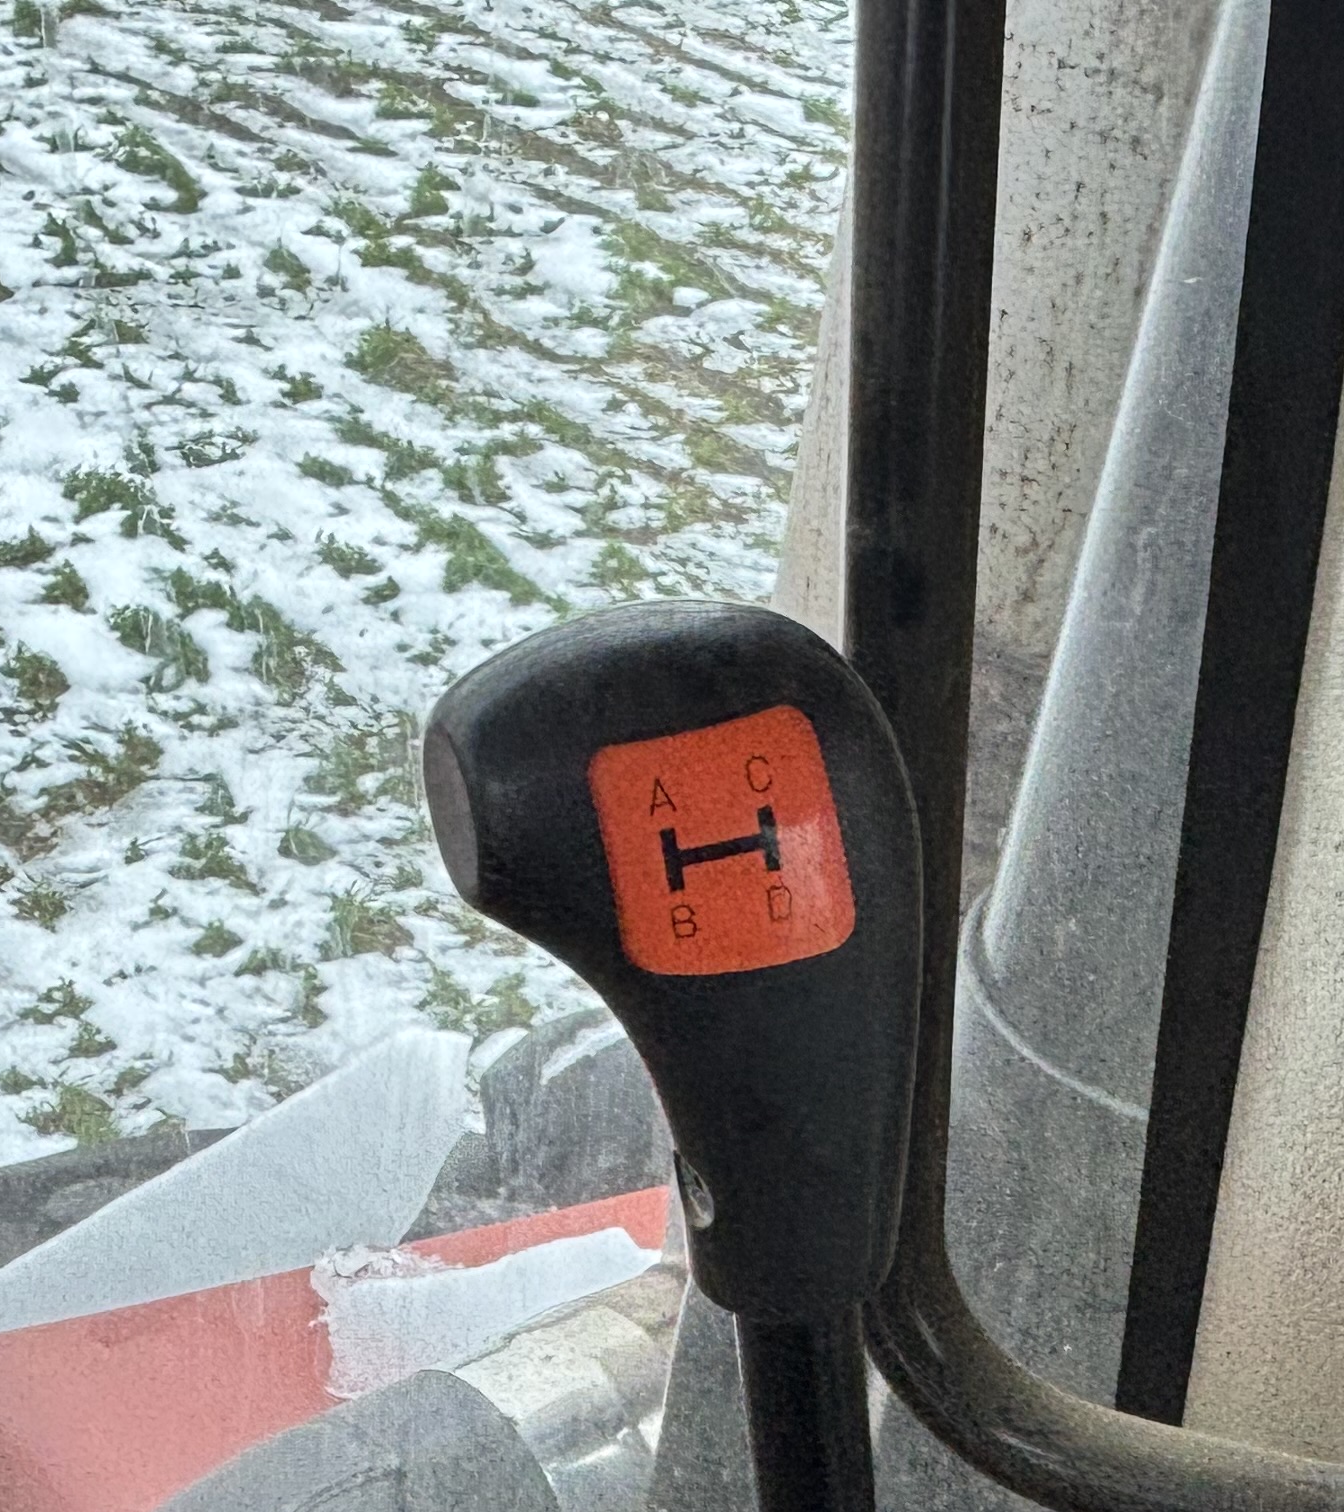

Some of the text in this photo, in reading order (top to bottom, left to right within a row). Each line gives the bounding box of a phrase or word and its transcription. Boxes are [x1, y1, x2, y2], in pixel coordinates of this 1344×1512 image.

[745, 755, 772, 793] C
[650, 777, 677, 817] A
[670, 904, 698, 939] B
